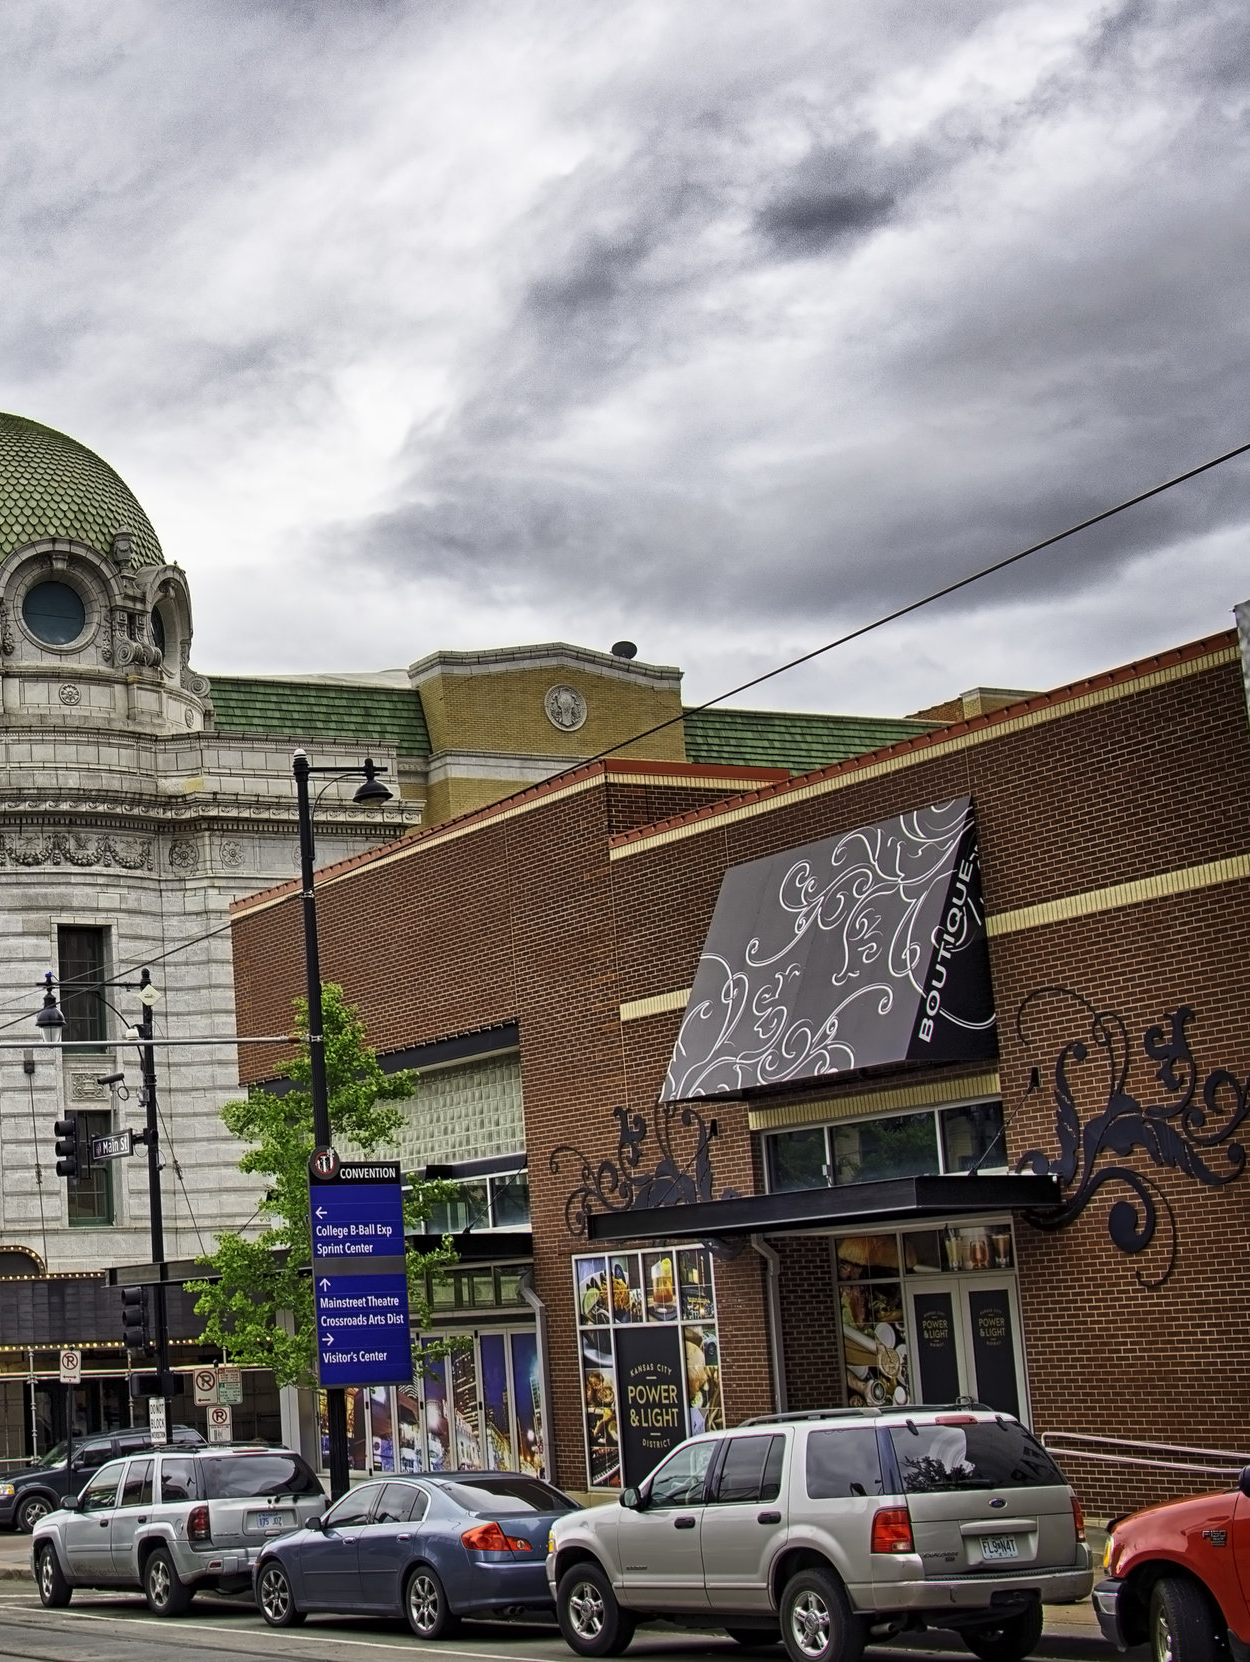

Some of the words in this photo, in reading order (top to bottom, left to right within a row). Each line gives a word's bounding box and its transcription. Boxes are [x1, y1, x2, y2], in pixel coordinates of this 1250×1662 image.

[102, 1138, 119, 1154] Main
[120, 1136, 128, 1151] St
[340, 1168, 396, 1179] CONVENTION
[316, 1225, 348, 1238] College
[350, 1224, 375, 1235] B-Ball
[376, 1224, 393, 1237] Exp
[317, 1243, 343, 1257] Sprint
[345, 1242, 373, 1253] Center
[320, 1298, 366, 1308] Mainstreet
[367, 1296, 399, 1306] Theatre
[320, 1314, 367, 1326] Crossroads
[368, 1314, 385, 1325] Arts
[387, 1313, 404, 1324] Dist
[923, 1320, 948, 1329] POWER
[979, 1318, 1005, 1327] POWER
[930, 1329, 948, 1338] LIGHT
[986, 1328, 1005, 1336] LIGHT
[323, 1351, 357, 1363] Visitor's
[359, 1351, 387, 1362] Center
[630, 1363, 654, 1377] KANSAS
[656, 1363, 672, 1376] CITY
[628, 1385, 678, 1405] POWER
[641, 1408, 678, 1427] LIGHT
[642, 1438, 670, 1449] DISTRICT
